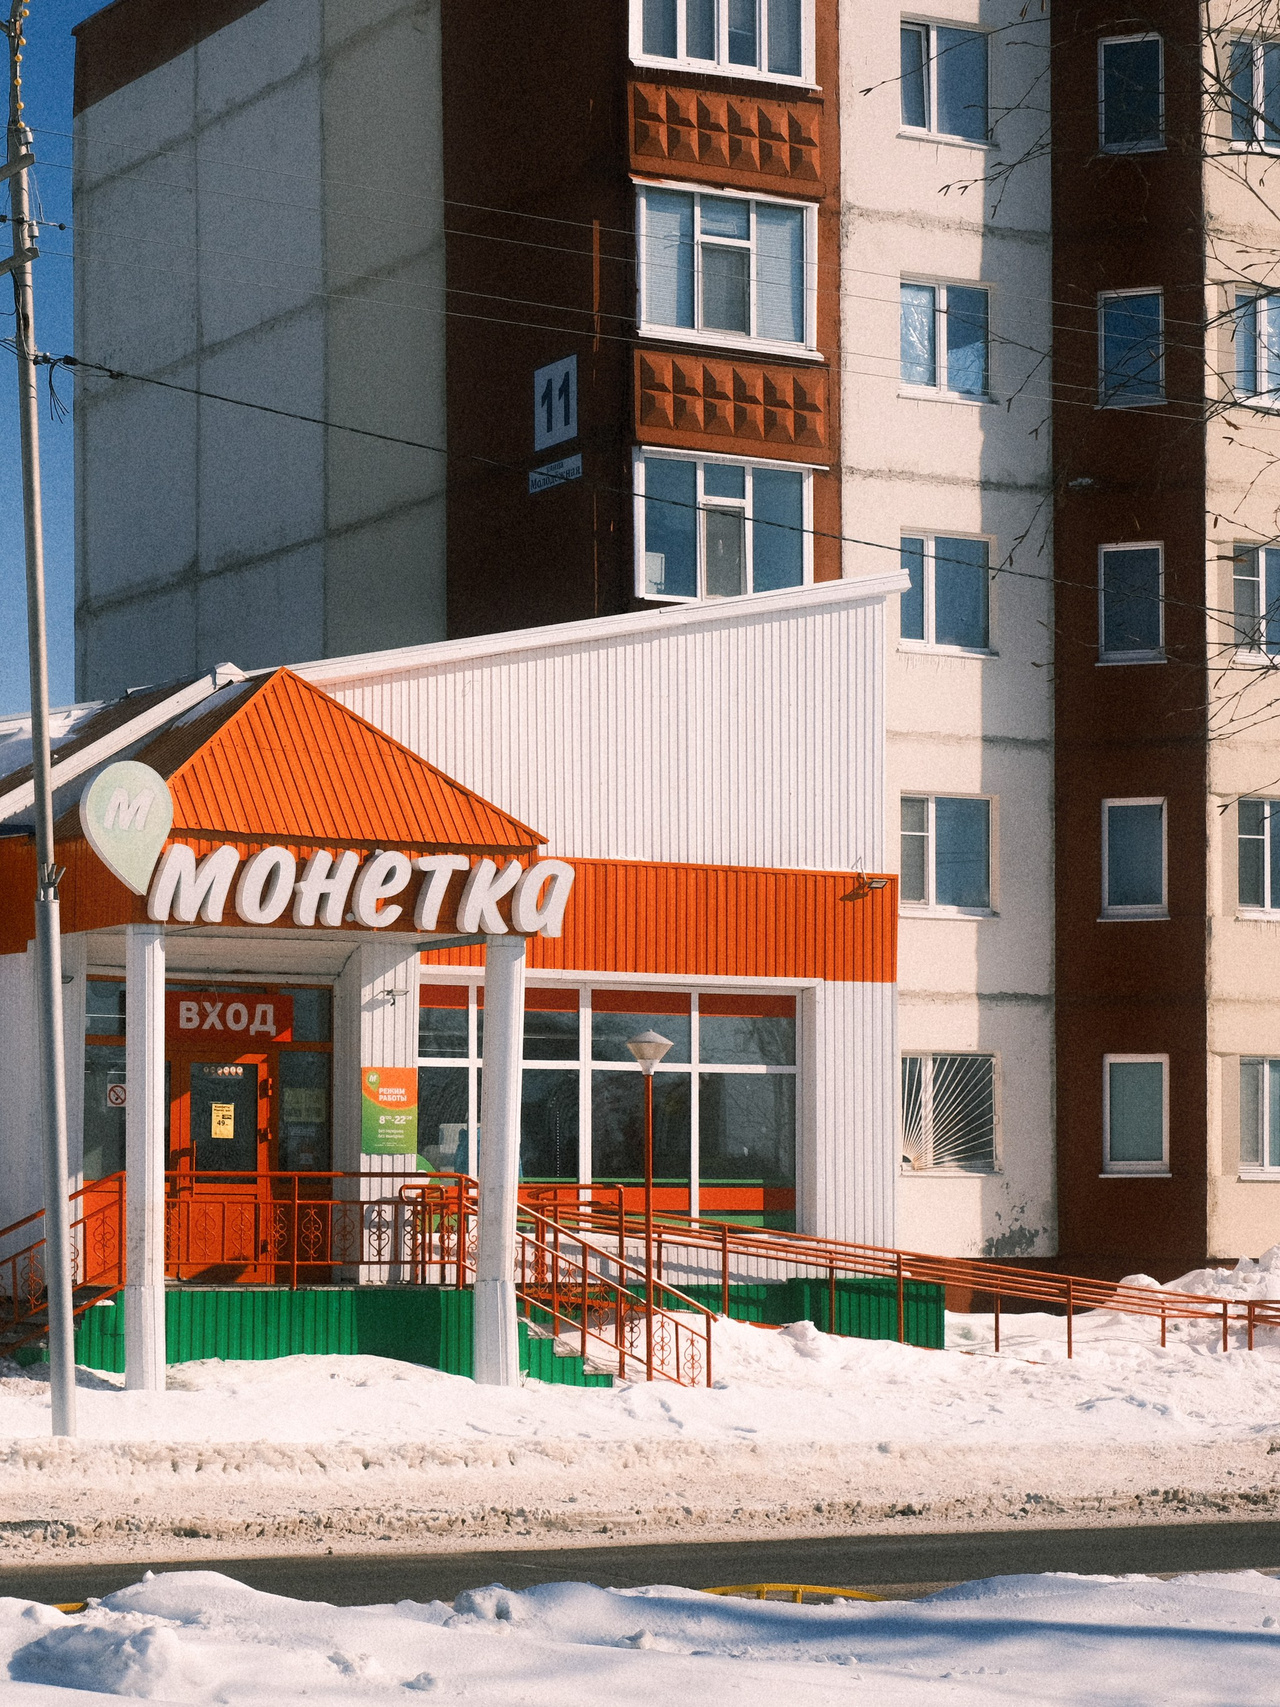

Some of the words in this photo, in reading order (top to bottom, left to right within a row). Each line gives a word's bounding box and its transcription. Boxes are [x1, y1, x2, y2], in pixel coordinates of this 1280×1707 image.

[541, 371, 570, 433] 11
[179, 1000, 277, 1037] ВХОД
[378, 1087, 405, 1095] РЕЖИМ
[378, 1094, 407, 1102] РАБОТЫ
